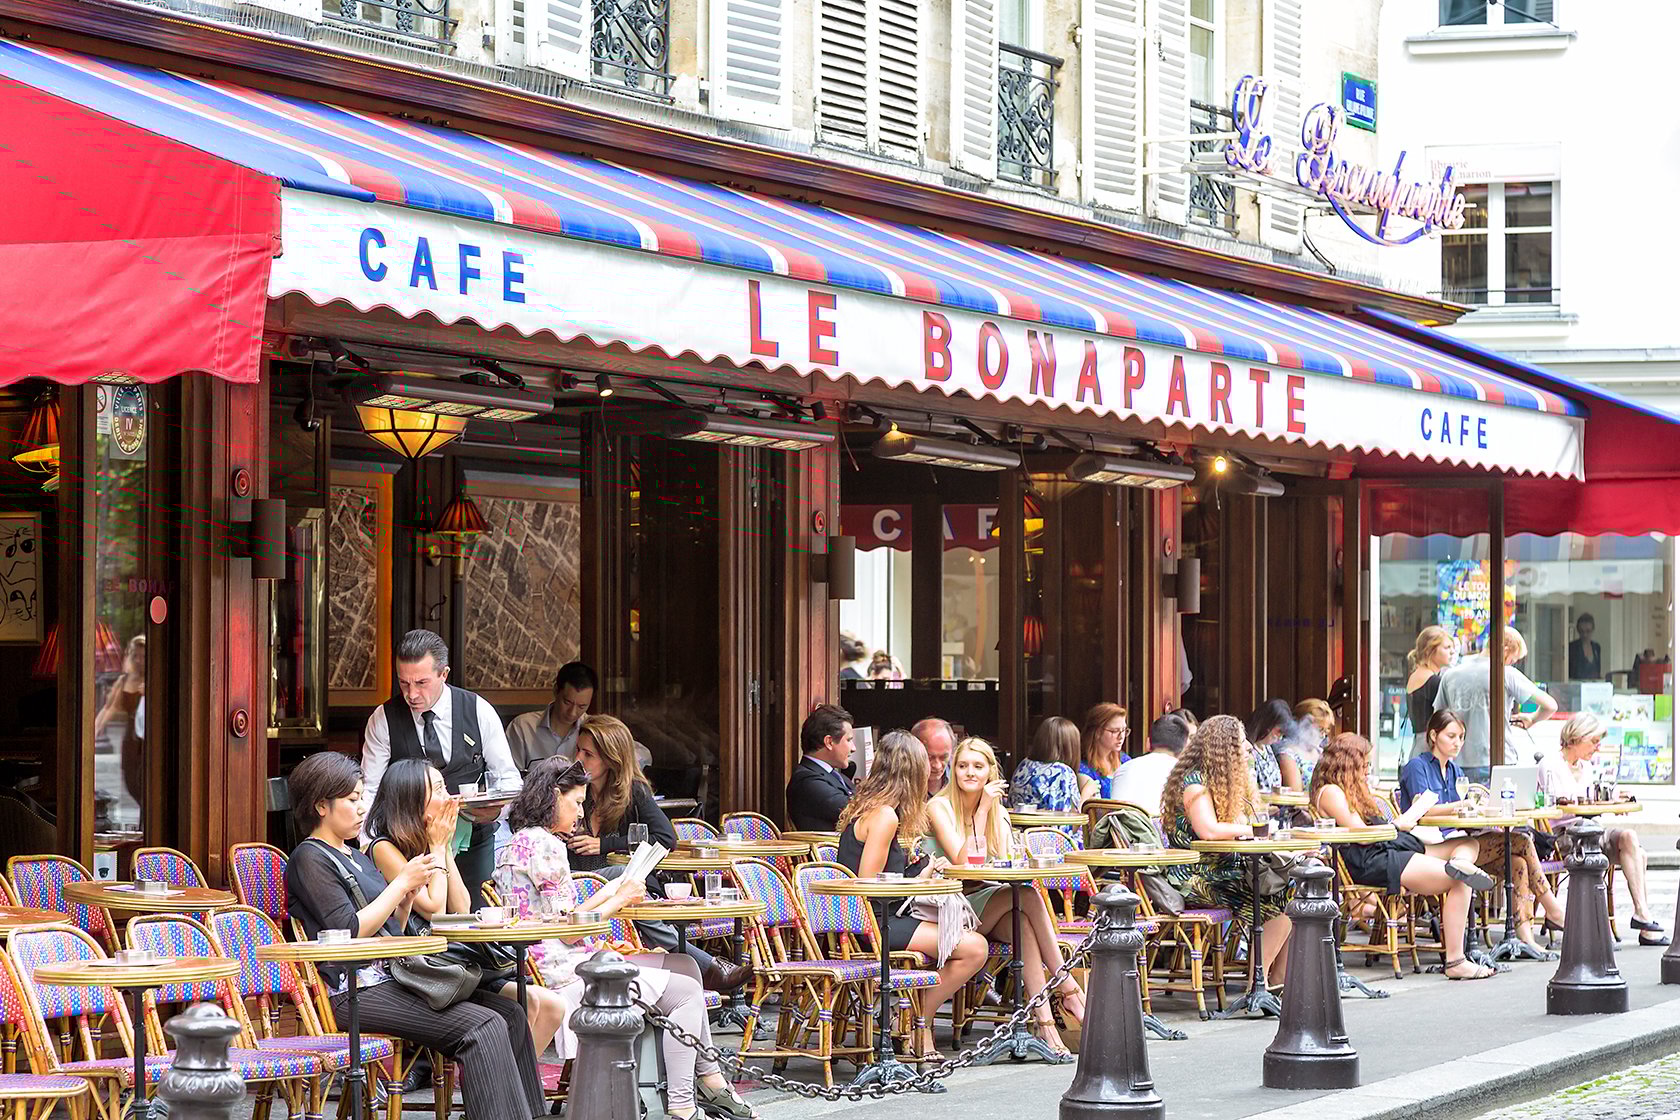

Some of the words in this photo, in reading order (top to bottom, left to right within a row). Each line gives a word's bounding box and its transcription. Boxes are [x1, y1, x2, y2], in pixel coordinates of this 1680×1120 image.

[359, 227, 526, 304] CAFE
[748, 279, 839, 367] LE
[923, 310, 1306, 434] BONAPARTE
[1420, 407, 1488, 450] CAFE
